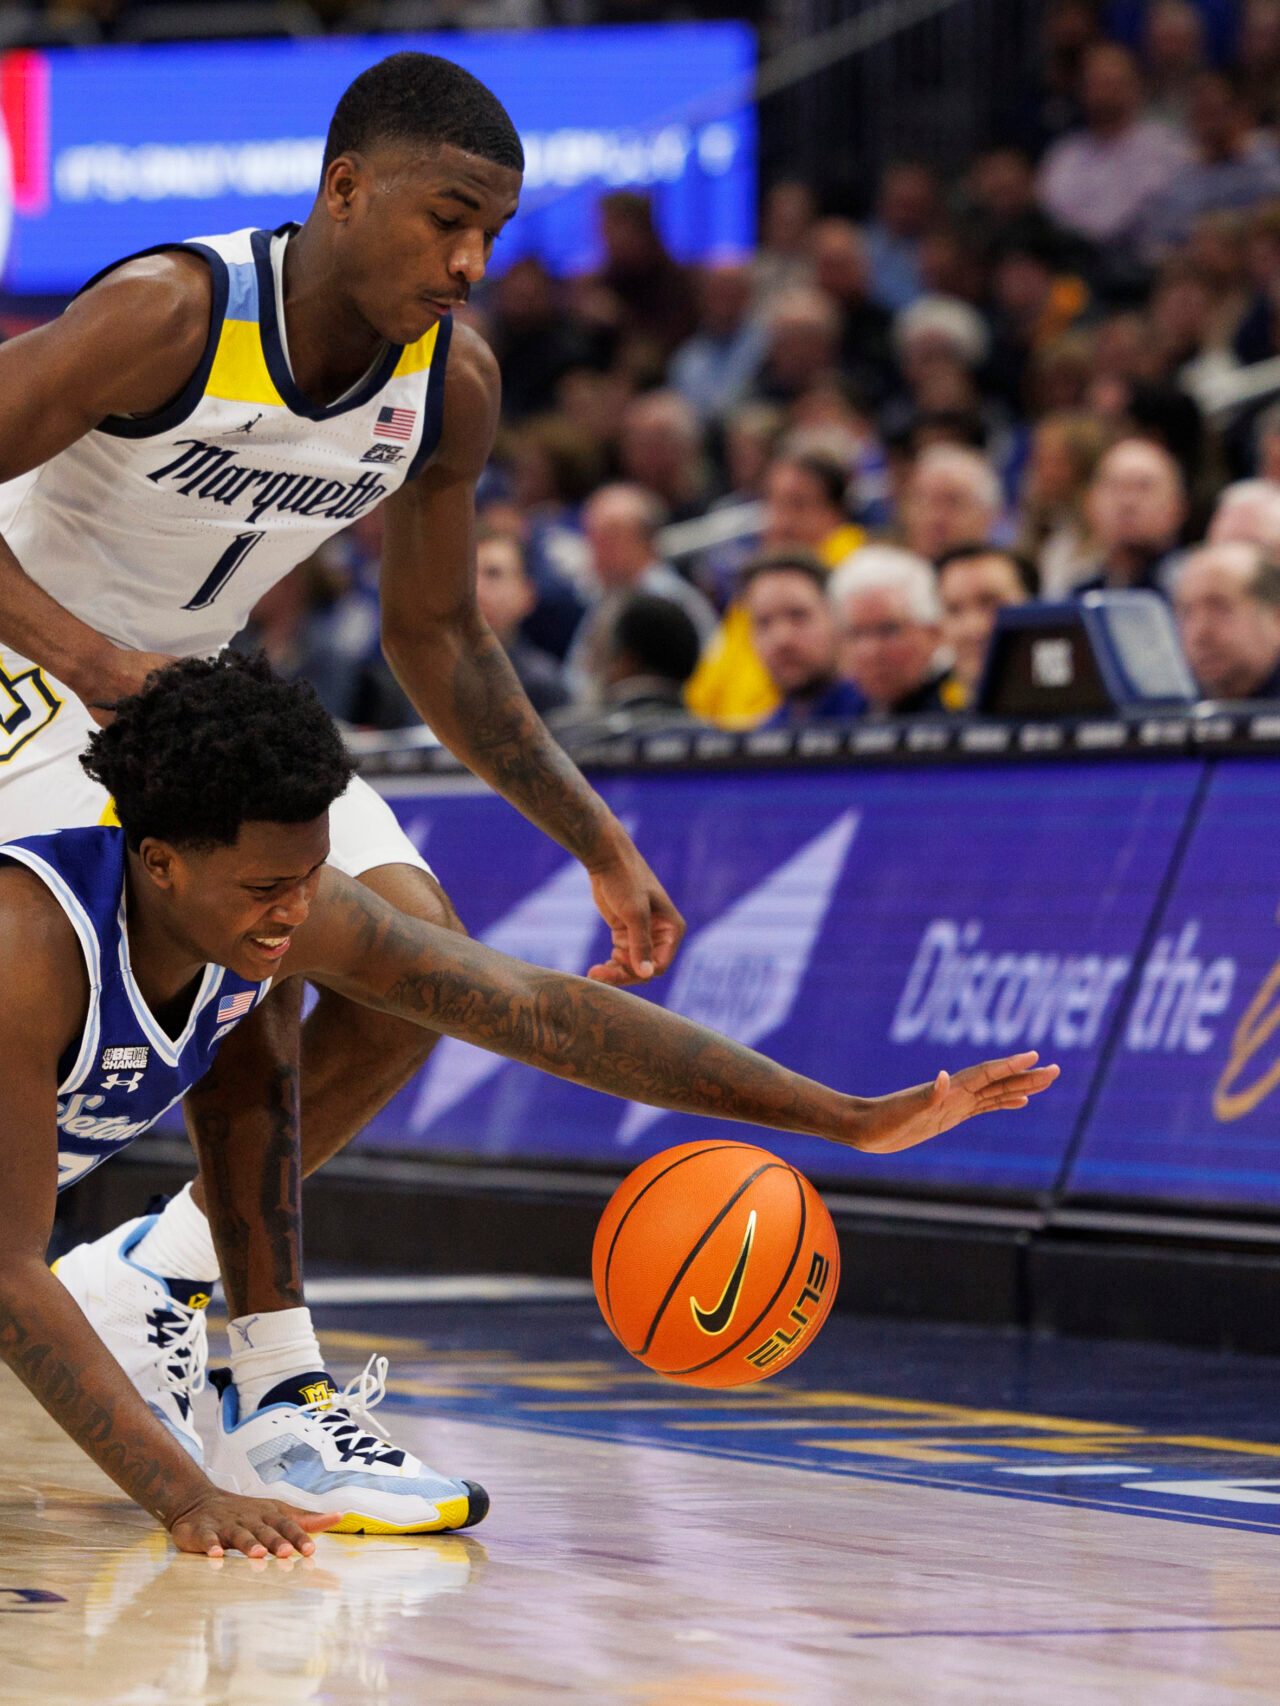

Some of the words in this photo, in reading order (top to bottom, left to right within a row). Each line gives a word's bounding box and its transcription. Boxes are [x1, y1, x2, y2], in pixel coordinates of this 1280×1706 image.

[146, 439, 388, 524] Marquette
[181, 531, 266, 611] 1
[891, 919, 1128, 1046] Discover
[1128, 919, 1237, 1053] the
[103, 1059, 147, 1070] CHANGE
[744, 1251, 829, 1368] ELITE
